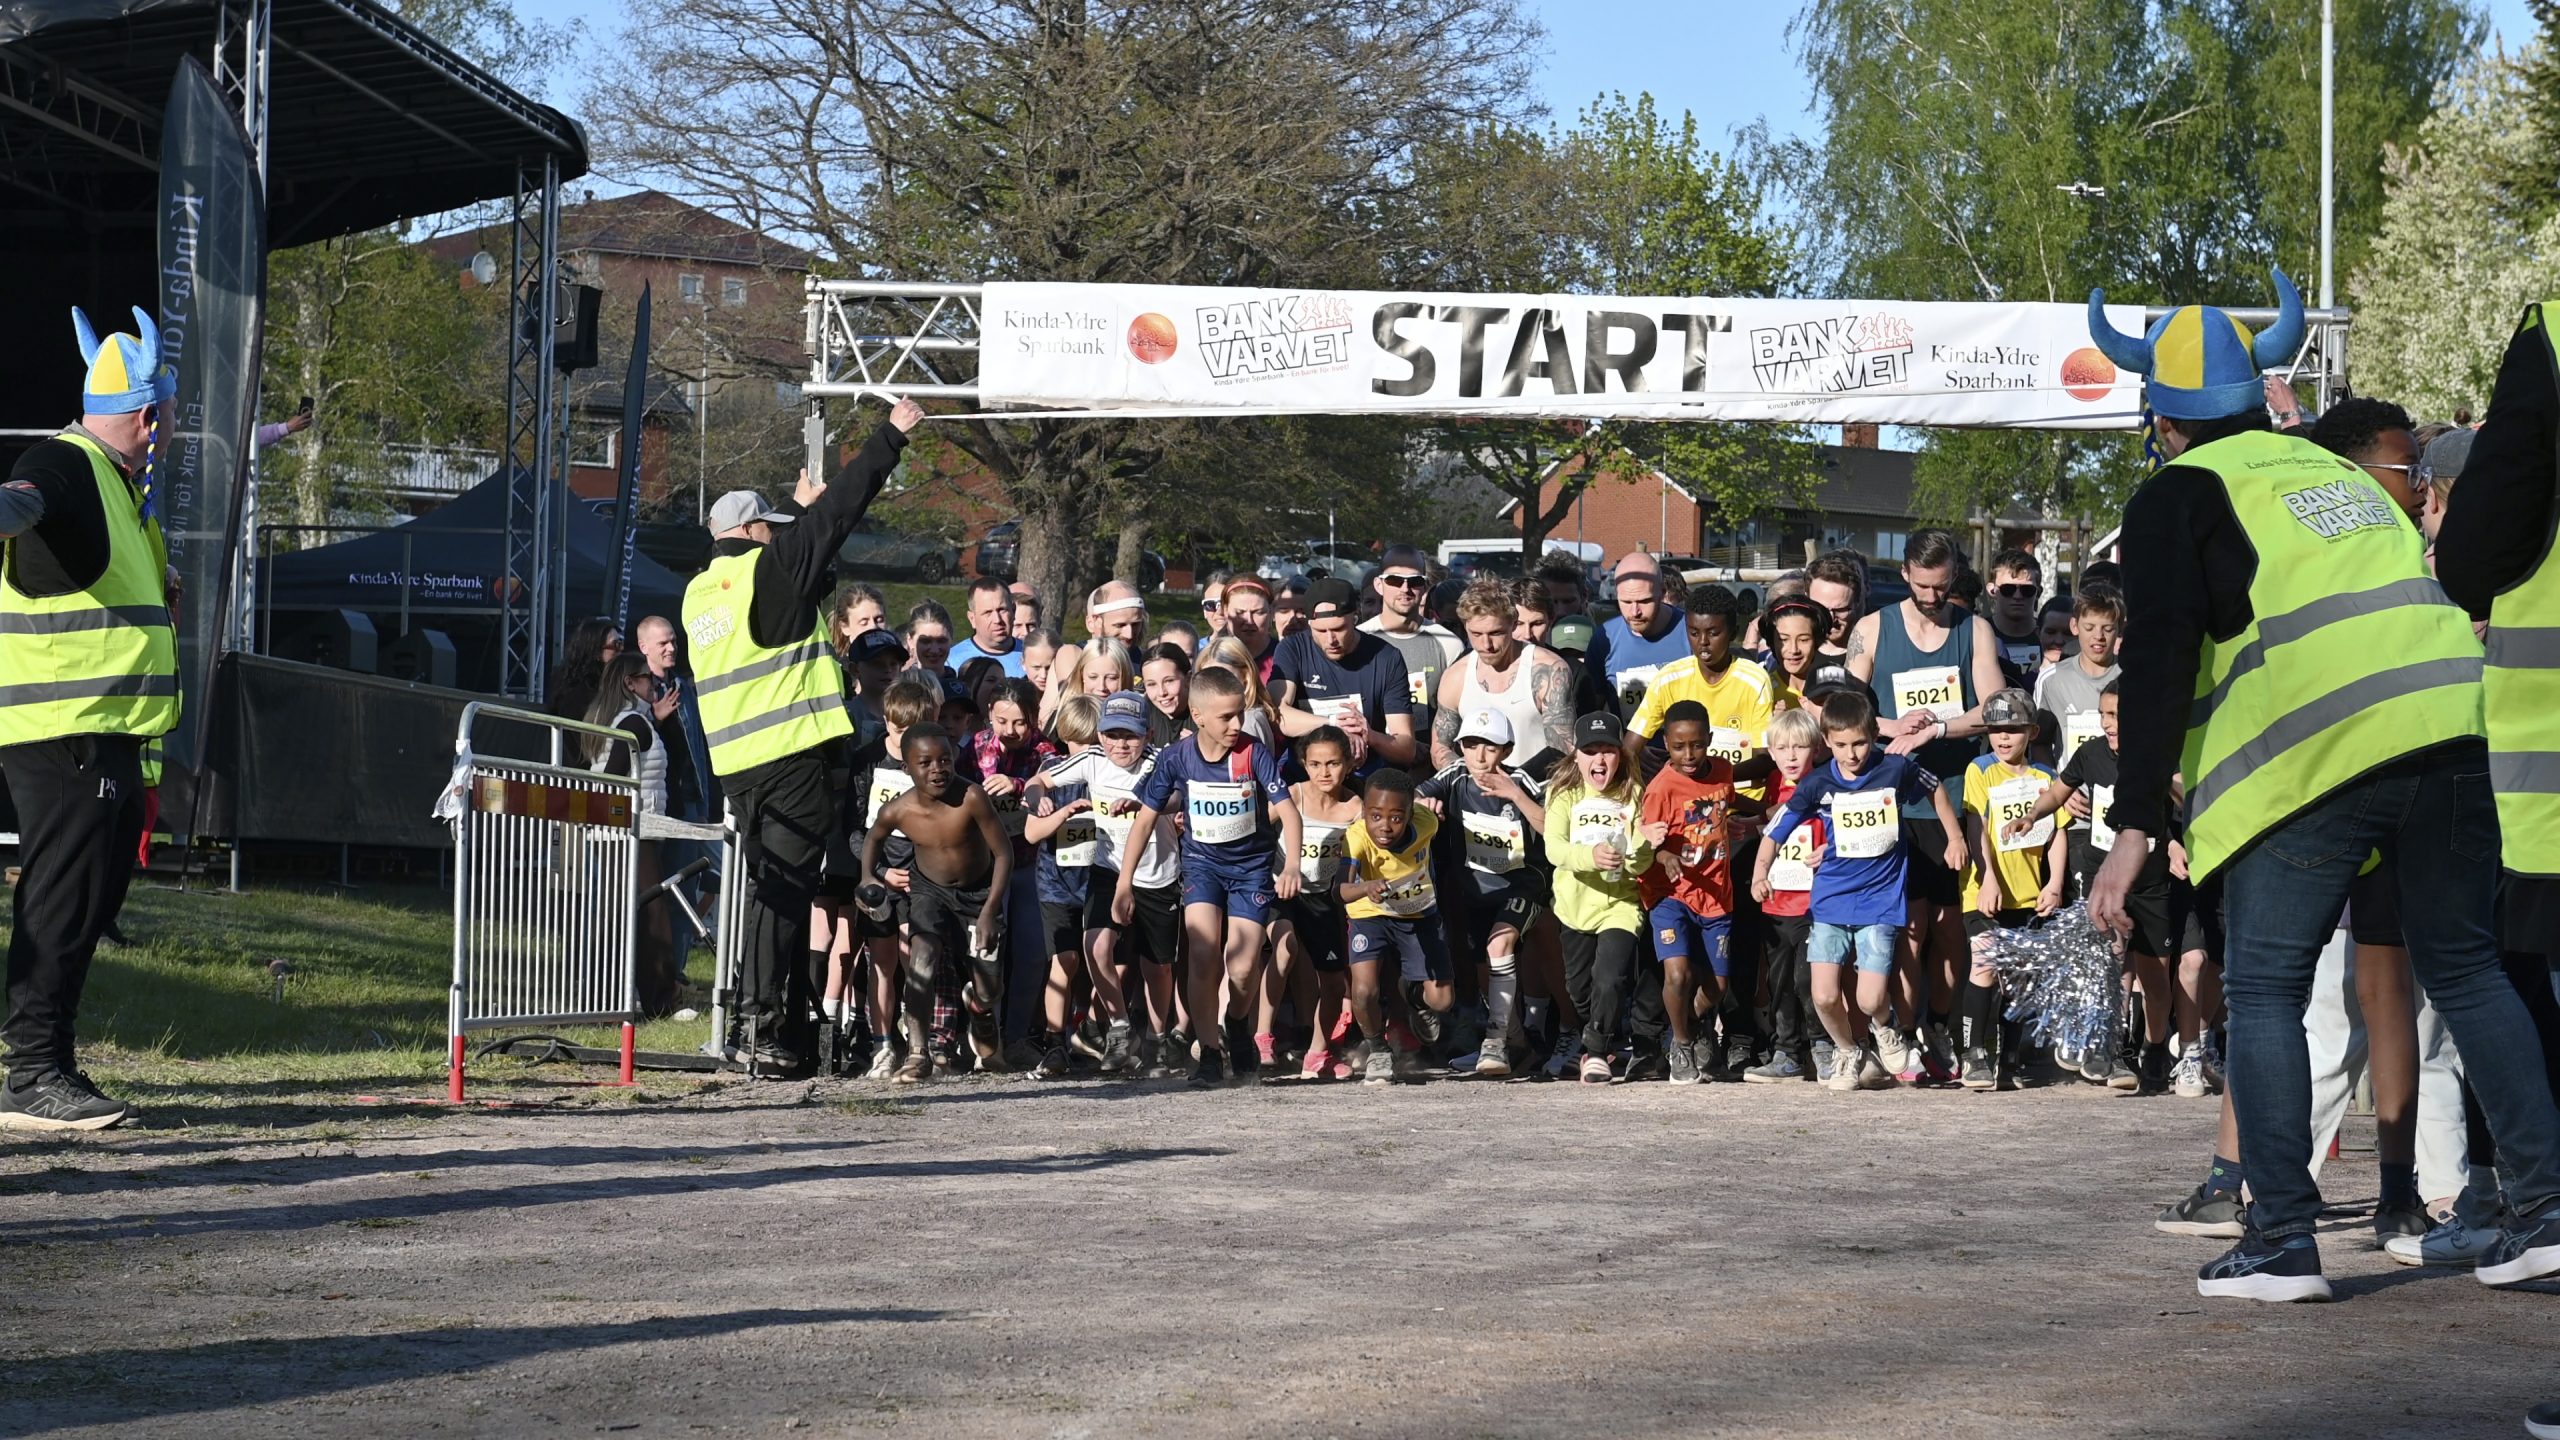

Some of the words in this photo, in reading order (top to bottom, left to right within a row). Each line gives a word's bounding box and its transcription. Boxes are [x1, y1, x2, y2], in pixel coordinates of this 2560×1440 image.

[1004, 310, 1108, 330] Kinda-Ydre
[1196, 295, 1301, 344] BANK
[1750, 315, 1858, 366] BANK
[1198, 324, 1353, 379] VARVET
[1371, 301, 1733, 406] START
[1929, 344, 2040, 367] Kinda-Ydre
[1753, 343, 1914, 393] VARVET
[2281, 480, 2355, 519] BANK
[423, 572, 484, 590] Sparbank
[435, 589, 452, 599] bank
[454, 590, 466, 600] för
[1906, 686, 1950, 707] 5021
[1193, 799, 1250, 816] 10051
[1842, 808, 1886, 828] 5381
[1473, 831, 1514, 852] 5394
[1776, 845, 1802, 862] 12
[1382, 883, 1424, 902] 413
